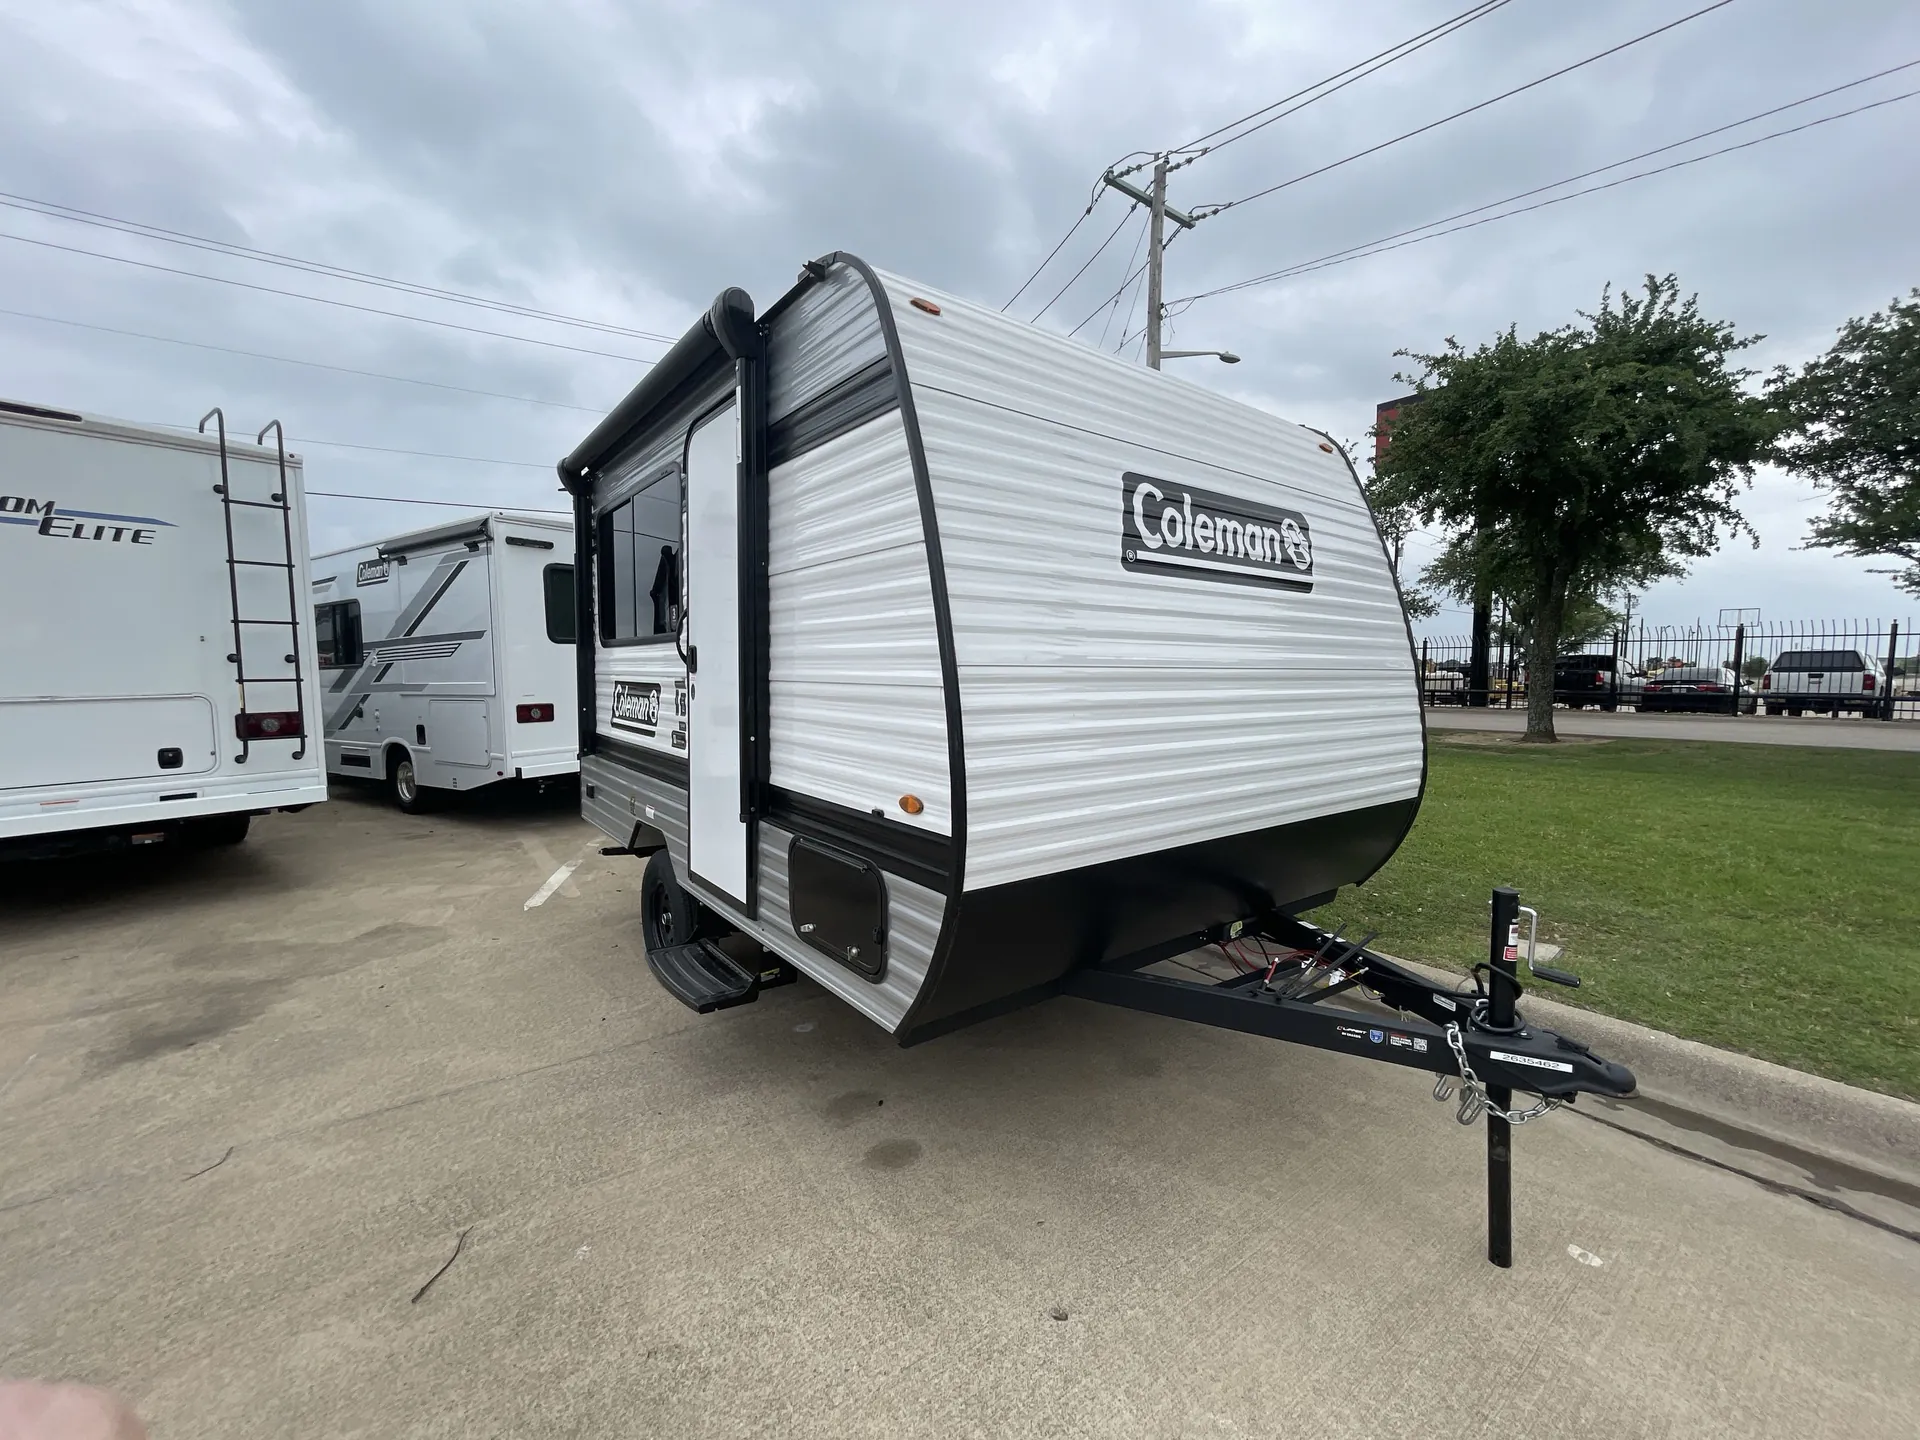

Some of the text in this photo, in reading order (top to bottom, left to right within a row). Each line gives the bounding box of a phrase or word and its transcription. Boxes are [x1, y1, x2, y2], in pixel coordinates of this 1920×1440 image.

[38, 516, 157, 545] ELITE
[1132, 482, 1282, 564] Coleman
[358, 563, 384, 581] Coleman
[614, 684, 649, 721] Coleman
[1502, 1054, 1560, 1069] 2635462
